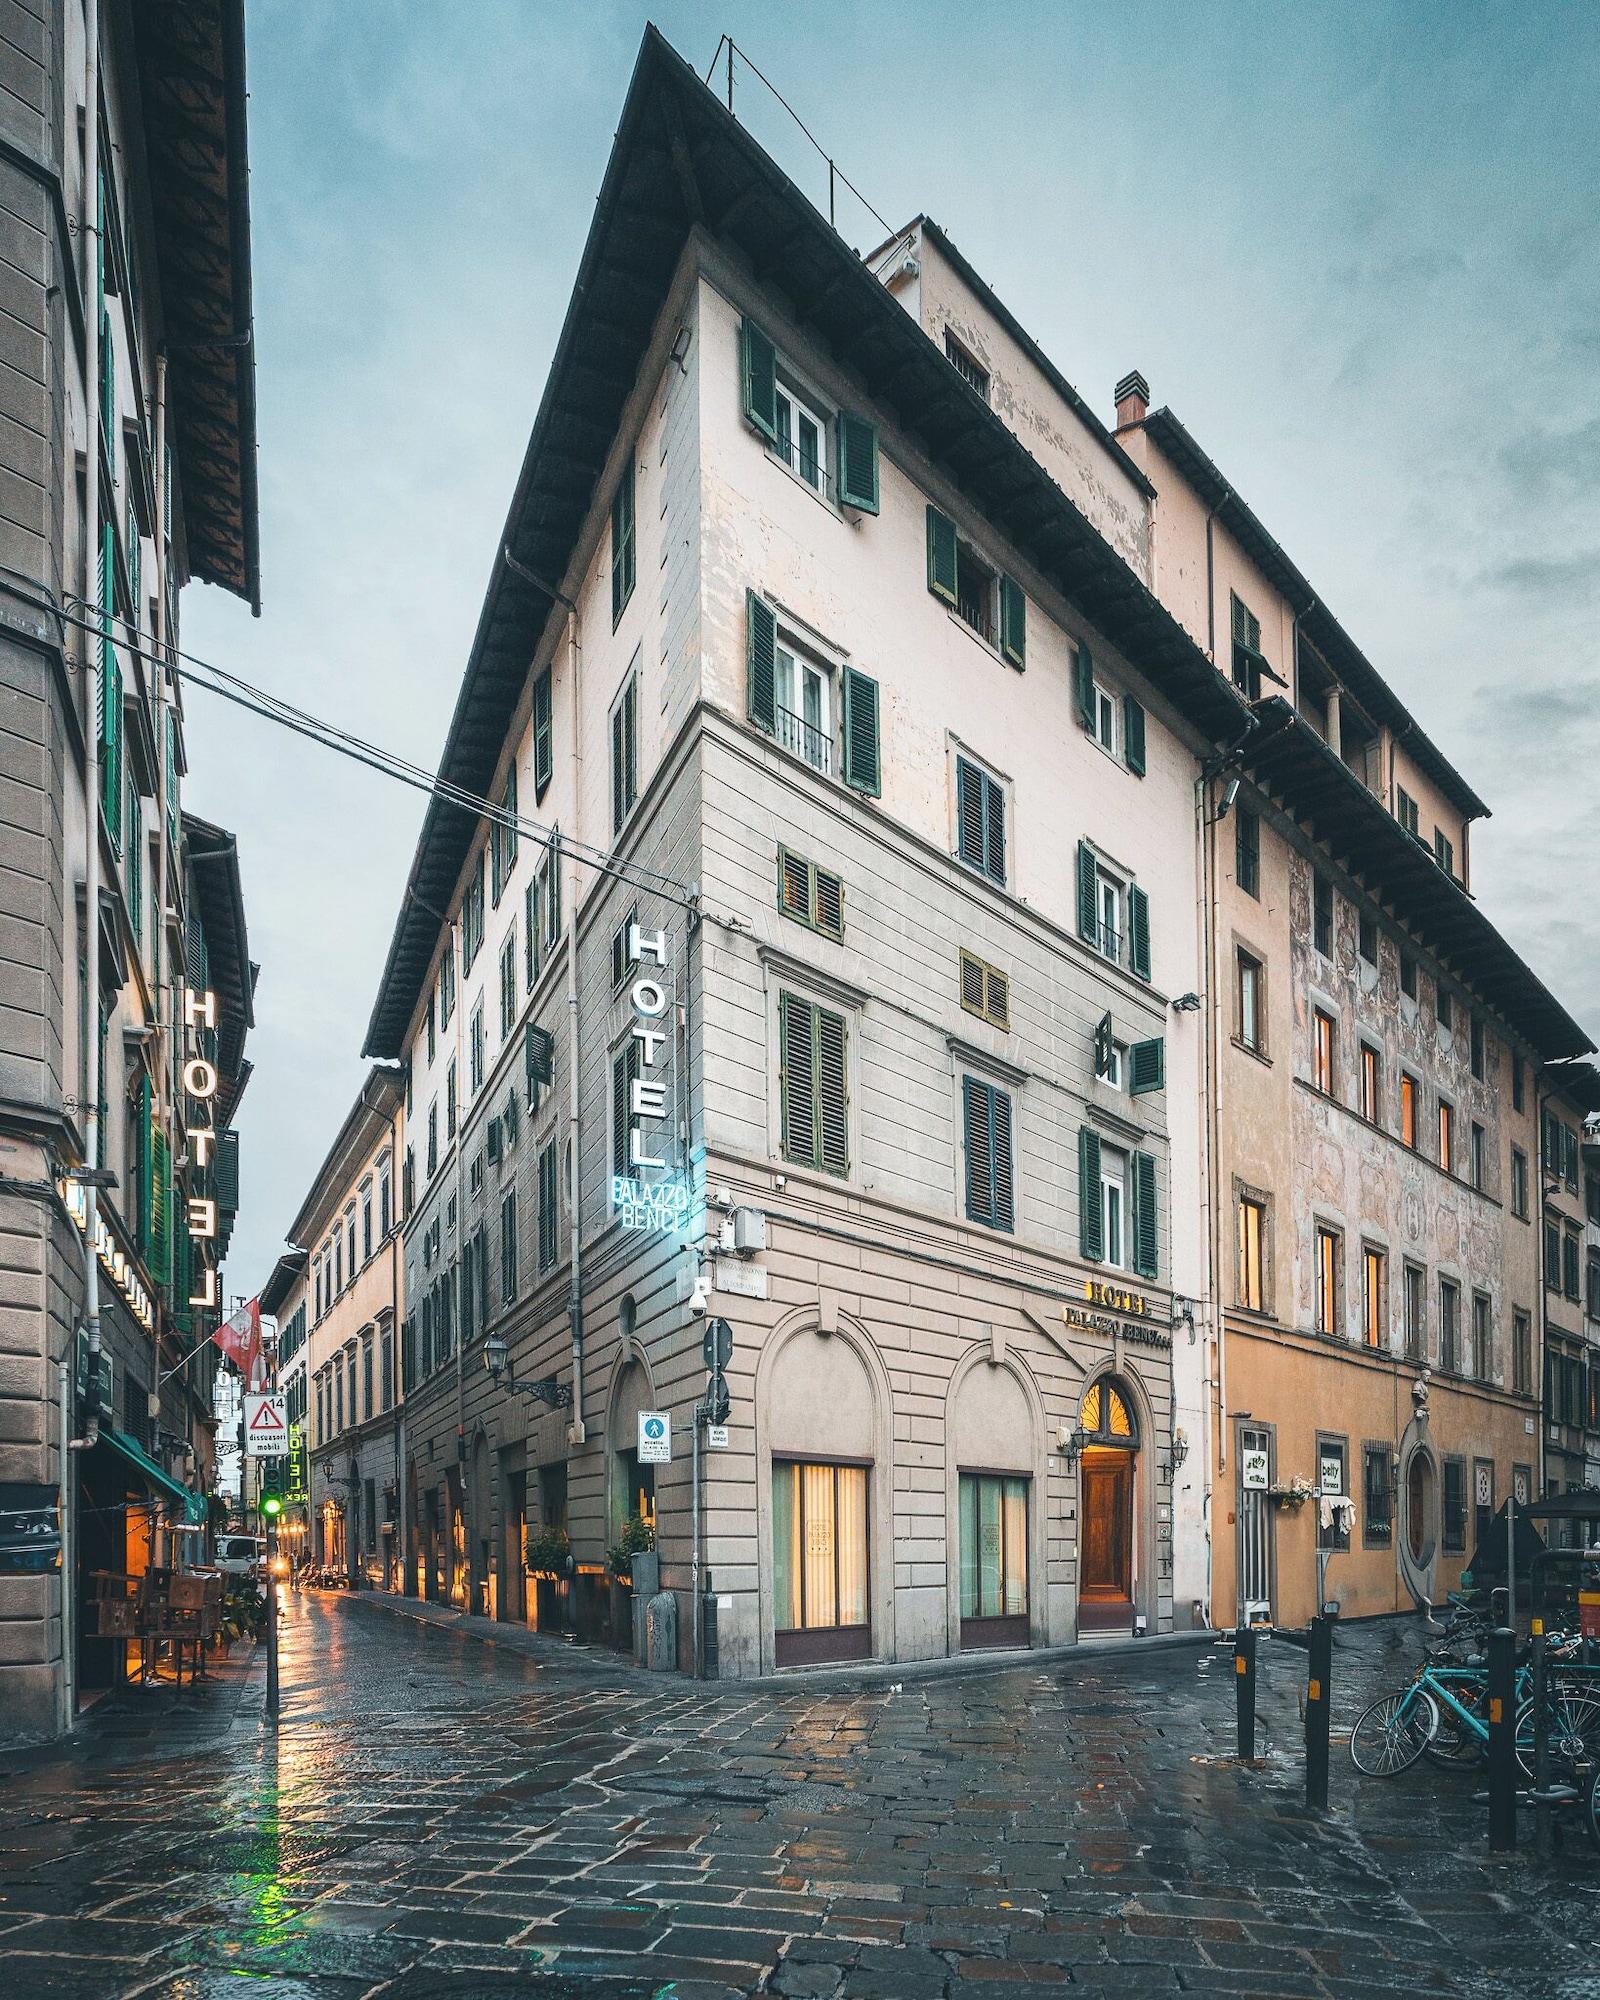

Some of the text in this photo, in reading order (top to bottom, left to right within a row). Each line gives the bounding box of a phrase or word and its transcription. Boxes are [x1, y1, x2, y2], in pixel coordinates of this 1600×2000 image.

[630, 923, 666, 1169] HOTEL
[622, 1203, 679, 1233] BENCI
[1088, 1281, 1152, 1316] HOTEL
[1065, 1307, 1120, 1336] PALAZZO
[269, 1398, 285, 1409] 14
[249, 1433, 286, 1442] dissuasori
